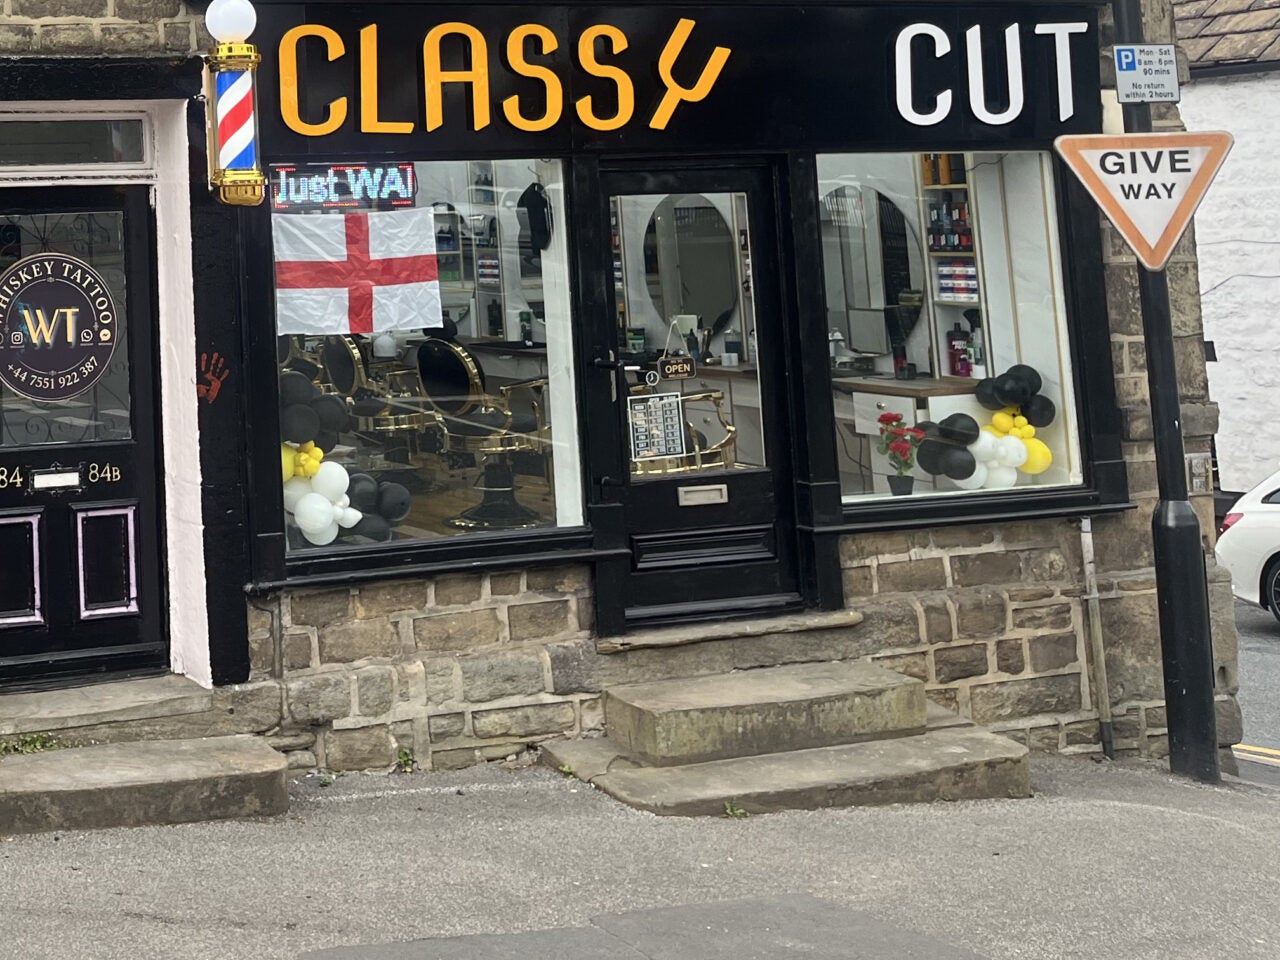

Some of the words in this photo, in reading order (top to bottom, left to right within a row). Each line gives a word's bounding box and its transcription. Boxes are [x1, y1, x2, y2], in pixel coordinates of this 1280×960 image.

[1120, 51, 1133, 69] P
[1158, 48, 1171, 56] Sat
[278, 17, 732, 137] CLASSY
[895, 22, 1089, 126] CUT
[1143, 68, 1153, 76] 90
[1132, 82, 1143, 90] No
[1144, 82, 1165, 90] return
[1148, 90, 1154, 98] 2
[1154, 90, 1174, 98] hours
[1099, 150, 1192, 176] GIVE
[1120, 182, 1177, 200] WAY
[62, 262, 113, 325] TATTOO
[23, 308, 80, 348] WT
[7, 364, 28, 382] +44
[29, 374, 55, 390] 7551
[58, 371, 80, 389] 922
[79, 355, 99, 378] 387
[665, 364, 690, 374] OPEN
[88, 463, 121, 482] 84B
